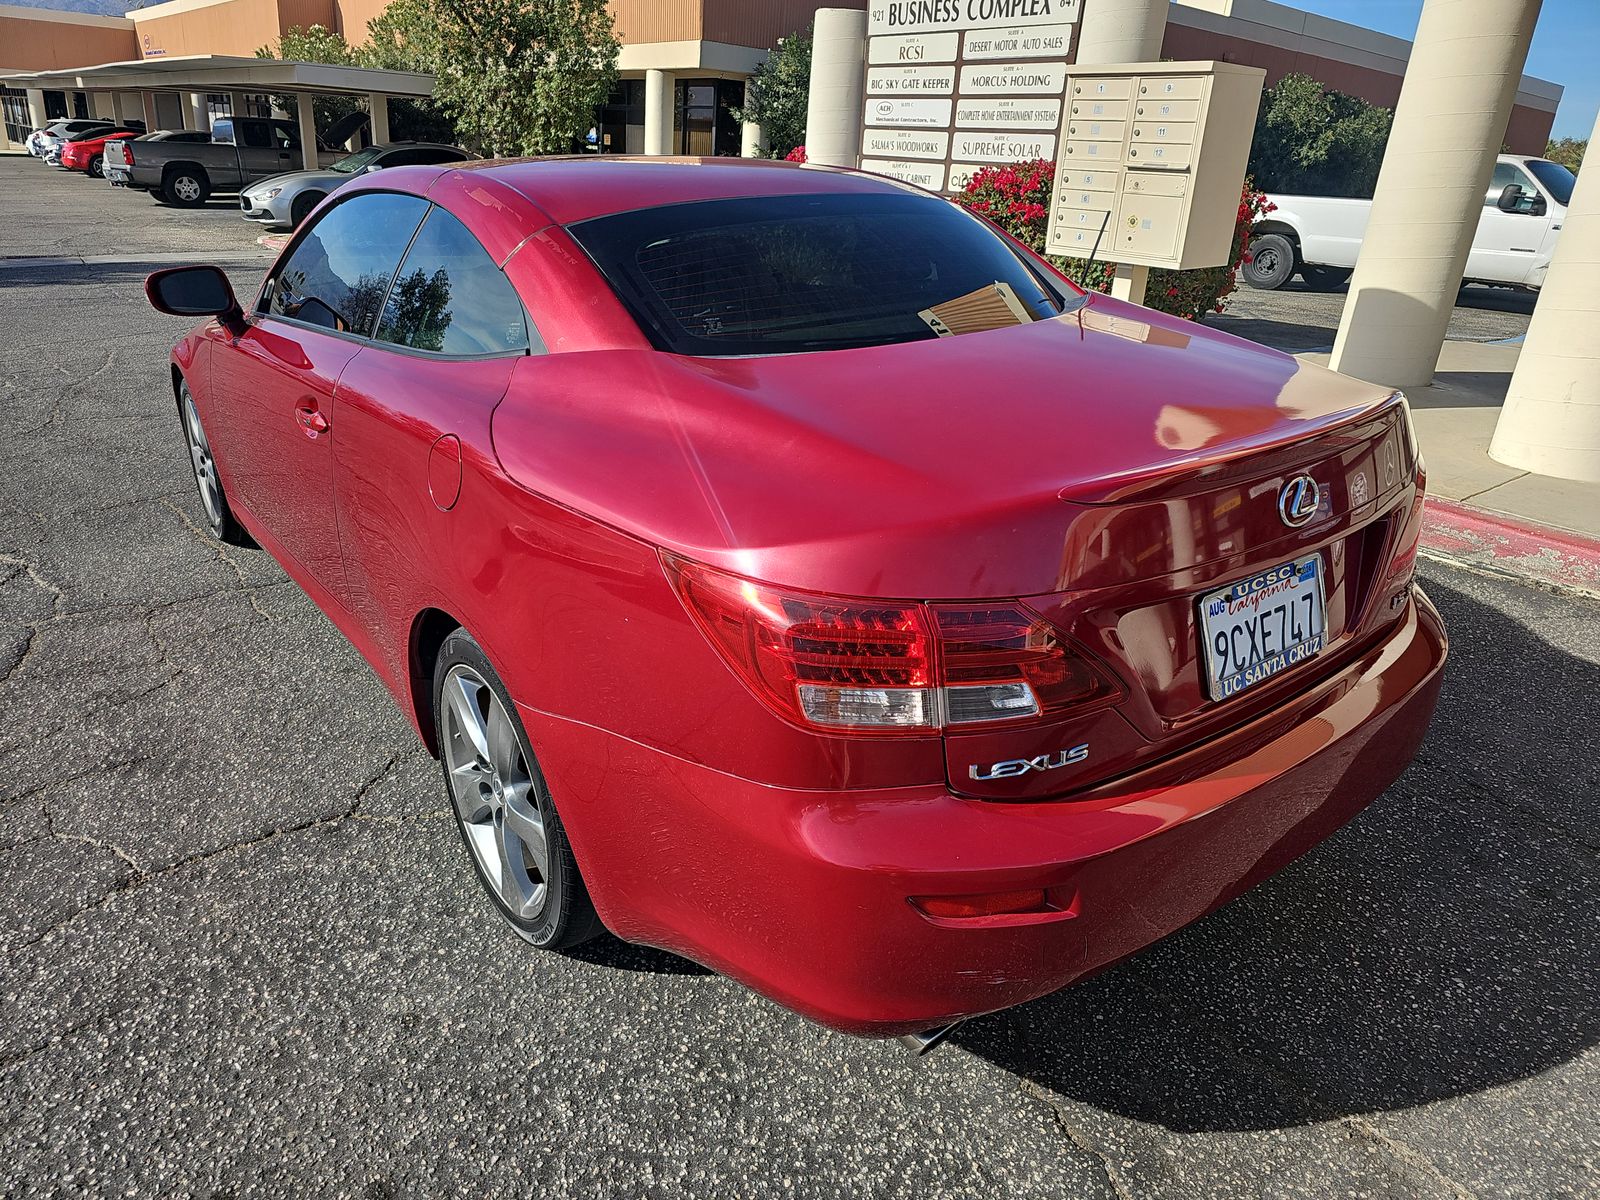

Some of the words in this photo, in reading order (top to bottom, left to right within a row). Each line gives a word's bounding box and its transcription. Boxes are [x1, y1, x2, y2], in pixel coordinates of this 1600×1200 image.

[872, 10, 884, 21] 921
[888, 0, 960, 26] BUSINESS
[967, 0, 1051, 21] COMPLEX
[969, 40, 992, 52] DESERT
[993, 39, 1018, 51] MOTOR
[1021, 38, 1041, 50] AUTO
[1042, 36, 1063, 49] SALES
[899, 45, 924, 60] RCSI
[871, 79, 884, 89] BIG
[886, 79, 900, 89] SKY
[901, 78, 920, 89] GATE
[922, 78, 950, 89] KEEPER
[970, 75, 1007, 87] MORCUS
[1009, 74, 1051, 86] HOLDING
[958, 110, 981, 121] COMPLETE
[981, 110, 996, 121] HOME
[996, 110, 1034, 121] ENTERTAINMENT
[1034, 110, 1057, 121] SYSTEMS
[1159, 128, 1166, 136] 11
[871, 139, 895, 151] SALMA'S
[896, 141, 939, 153] WOODWORKS
[962, 141, 1006, 156] SUPREME
[1007, 143, 1041, 157] SOLAR
[906, 173, 932, 184] CABINET
[1237, 566, 1291, 596] UCSC
[1228, 578, 1299, 615] California
[1209, 600, 1225, 618] AUG
[1214, 592, 1313, 681] 9CXE747
[1223, 674, 1242, 696] UC
[1245, 655, 1287, 685] SANTA
[1289, 637, 1320, 664] CRUZ
[968, 742, 1089, 780] LEXUS
